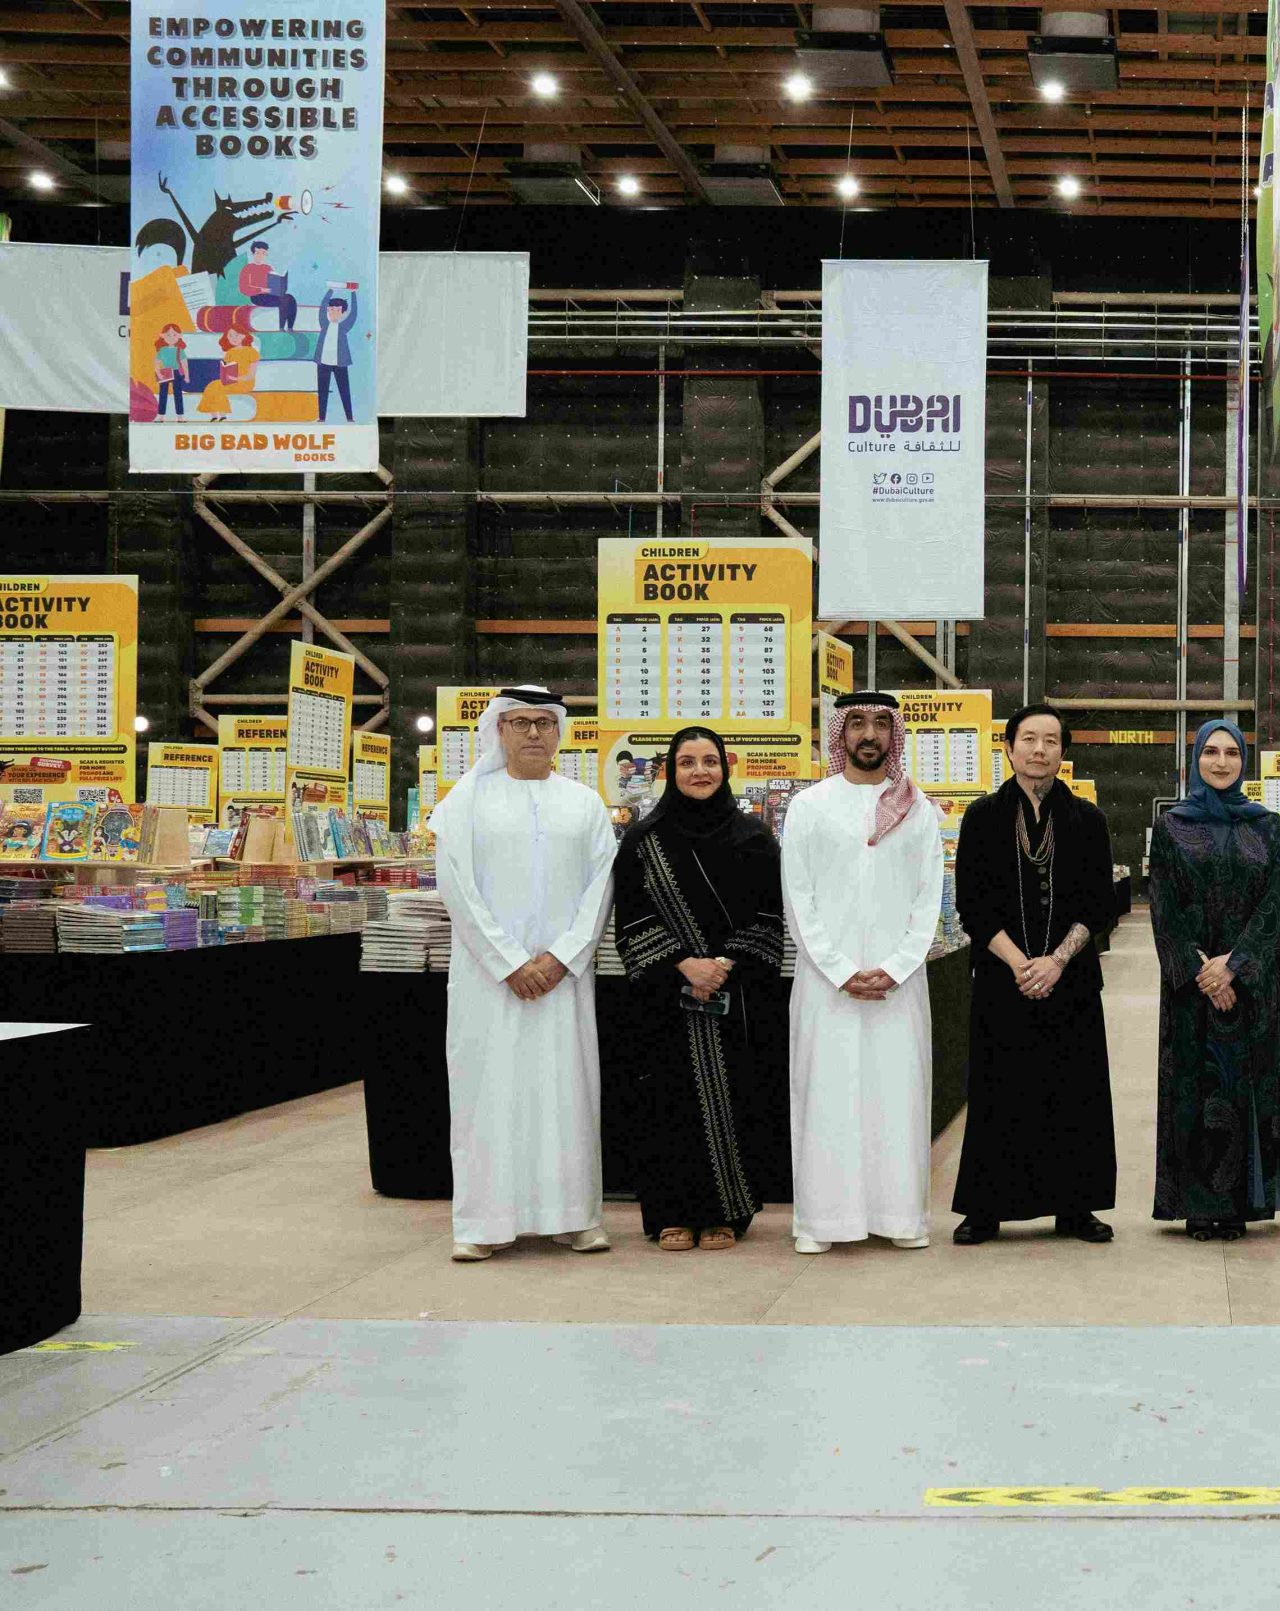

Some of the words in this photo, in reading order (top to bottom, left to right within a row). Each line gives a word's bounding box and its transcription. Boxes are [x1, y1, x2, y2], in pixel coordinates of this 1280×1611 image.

[148, 17, 365, 40] EMPOWERING
[146, 46, 367, 69] COMMUNITIES
[172, 76, 343, 100] THROUGH
[156, 105, 358, 130] ACCESSIBLE
[195, 135, 317, 158] BOOKS
[848, 395, 960, 438] DUBAI
[175, 434, 216, 450] BIG
[220, 434, 268, 450] BAD
[272, 433, 336, 450] WOLF
[848, 441, 896, 452] Culture
[904, 440, 960, 452] للثقافة
[294, 454, 336, 462] BOOKS
[642, 548, 699, 557] CHILDREN
[643, 564, 757, 581] ACTIVITY
[644, 584, 709, 600] BOOK
[826, 652, 845, 670] ACTIVITY
[305, 662, 339, 678] ACTIVITY
[304, 674, 324, 688] BOOK
[903, 702, 962, 712] ACTIVITY
[903, 714, 937, 722] BOOK
[1109, 731, 1153, 743] NORTH
[164, 754, 213, 763] REFERENCE
